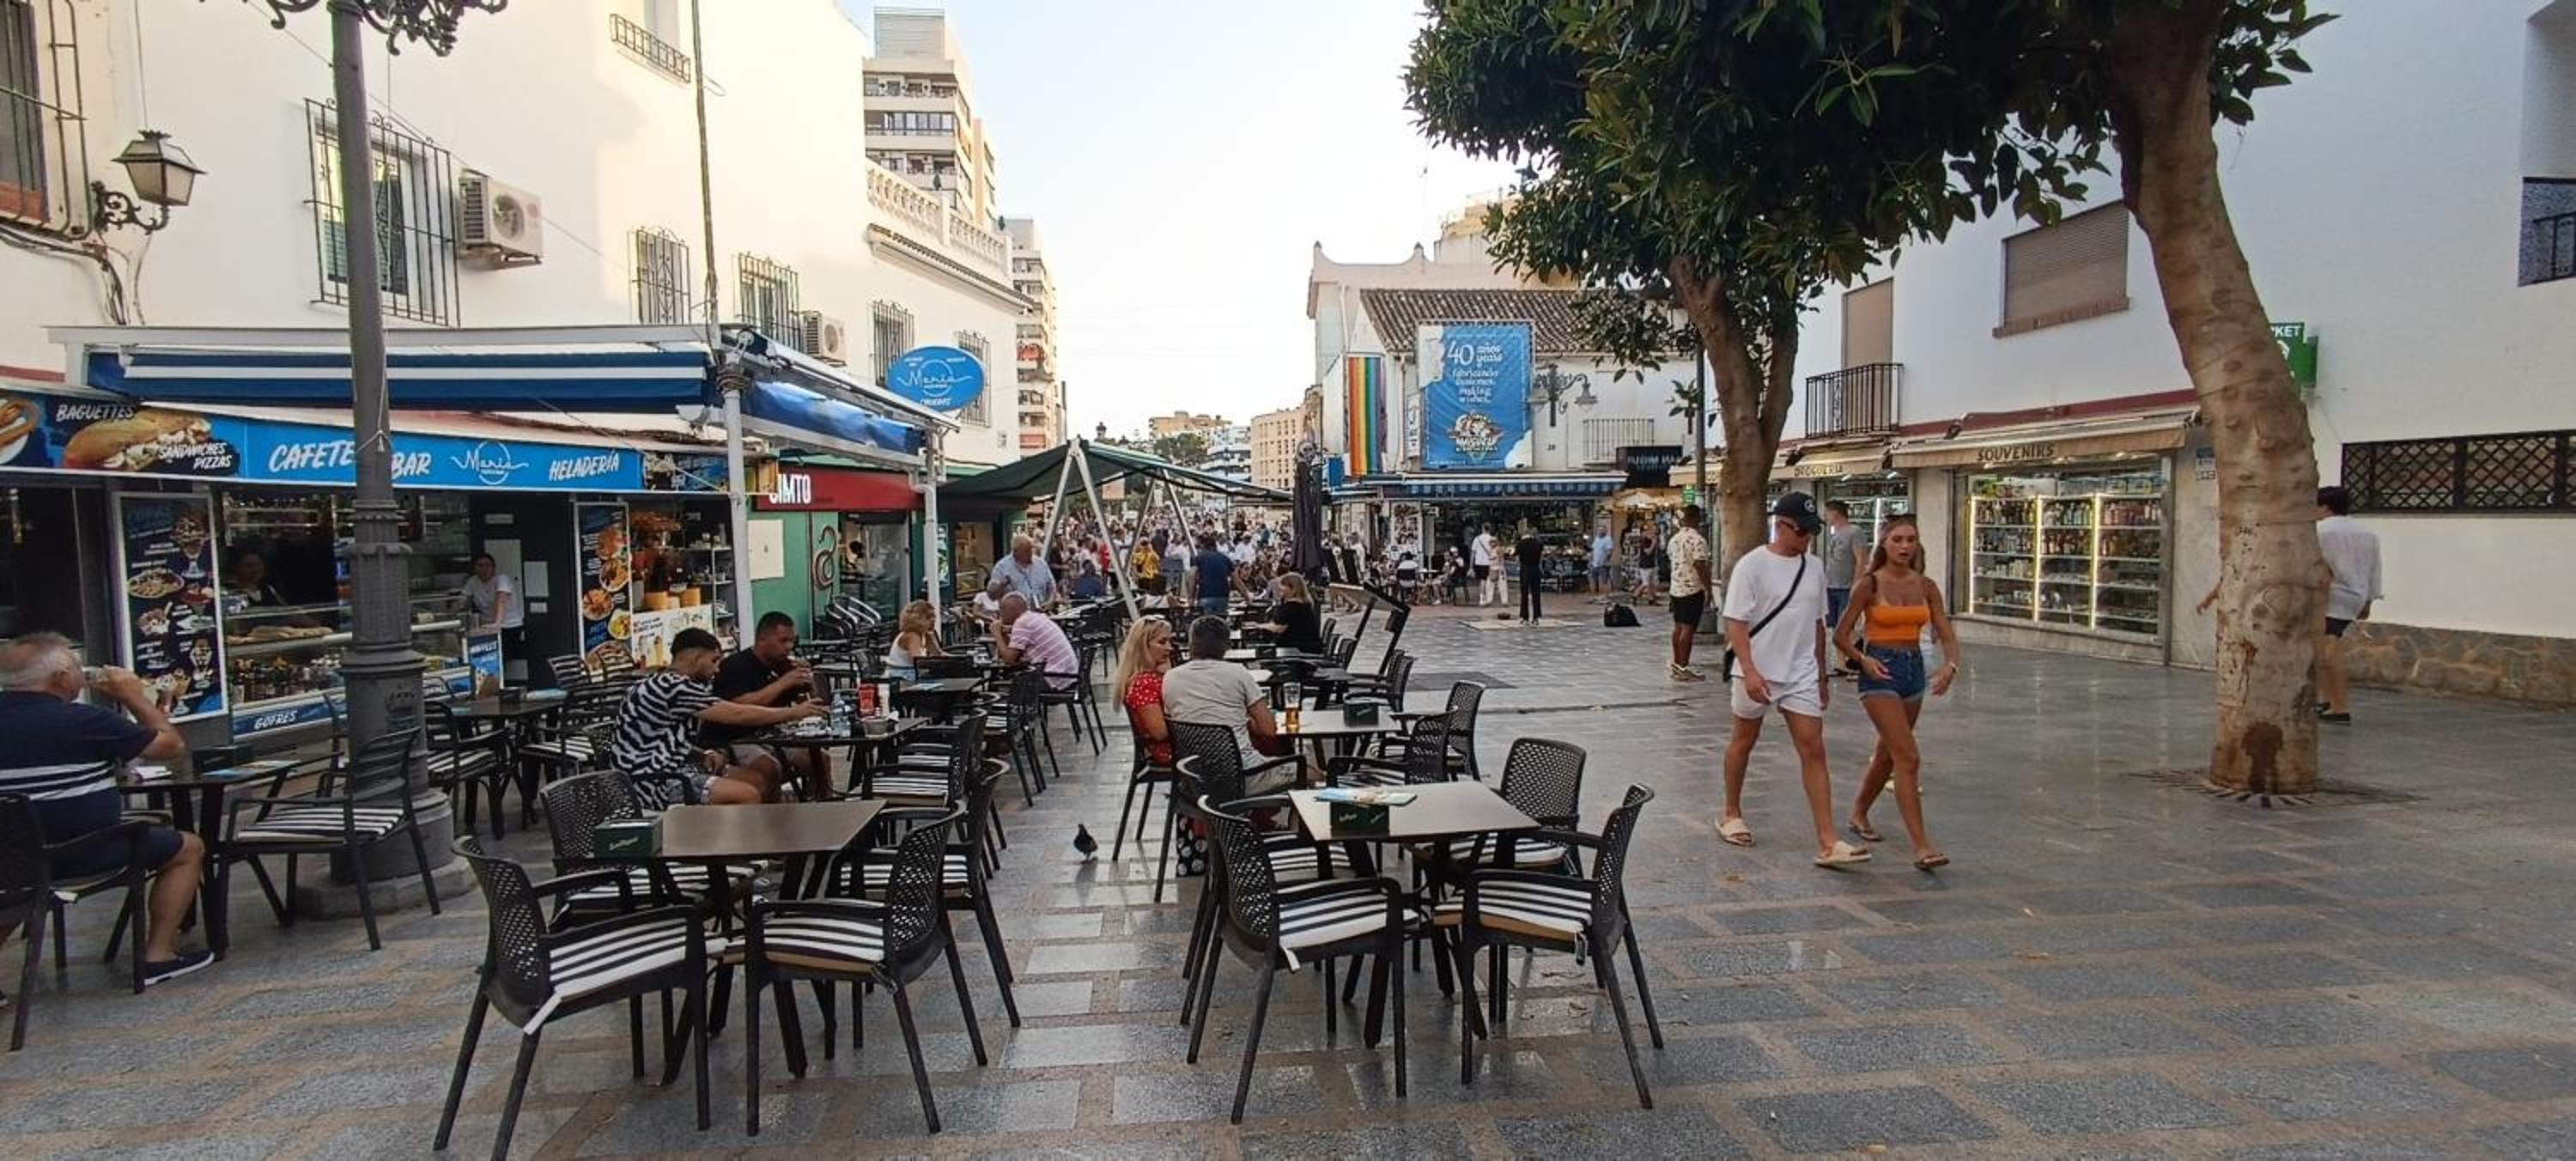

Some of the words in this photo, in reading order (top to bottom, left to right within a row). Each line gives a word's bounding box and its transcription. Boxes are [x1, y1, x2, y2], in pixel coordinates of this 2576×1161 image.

[2270, 325, 2301, 337] KET
[1447, 340, 1474, 366] 40
[56, 404, 133, 422] BAGUETTES
[158, 442, 227, 459] SANDWICHES
[1977, 443, 2055, 461] SOUVENIRS
[193, 455, 232, 470] PIZZAS
[269, 440, 356, 472] CAFETE
[391, 452, 431, 479] BAR
[549, 450, 619, 481] HELADERÍA
[254, 710, 298, 730] GOFRES
